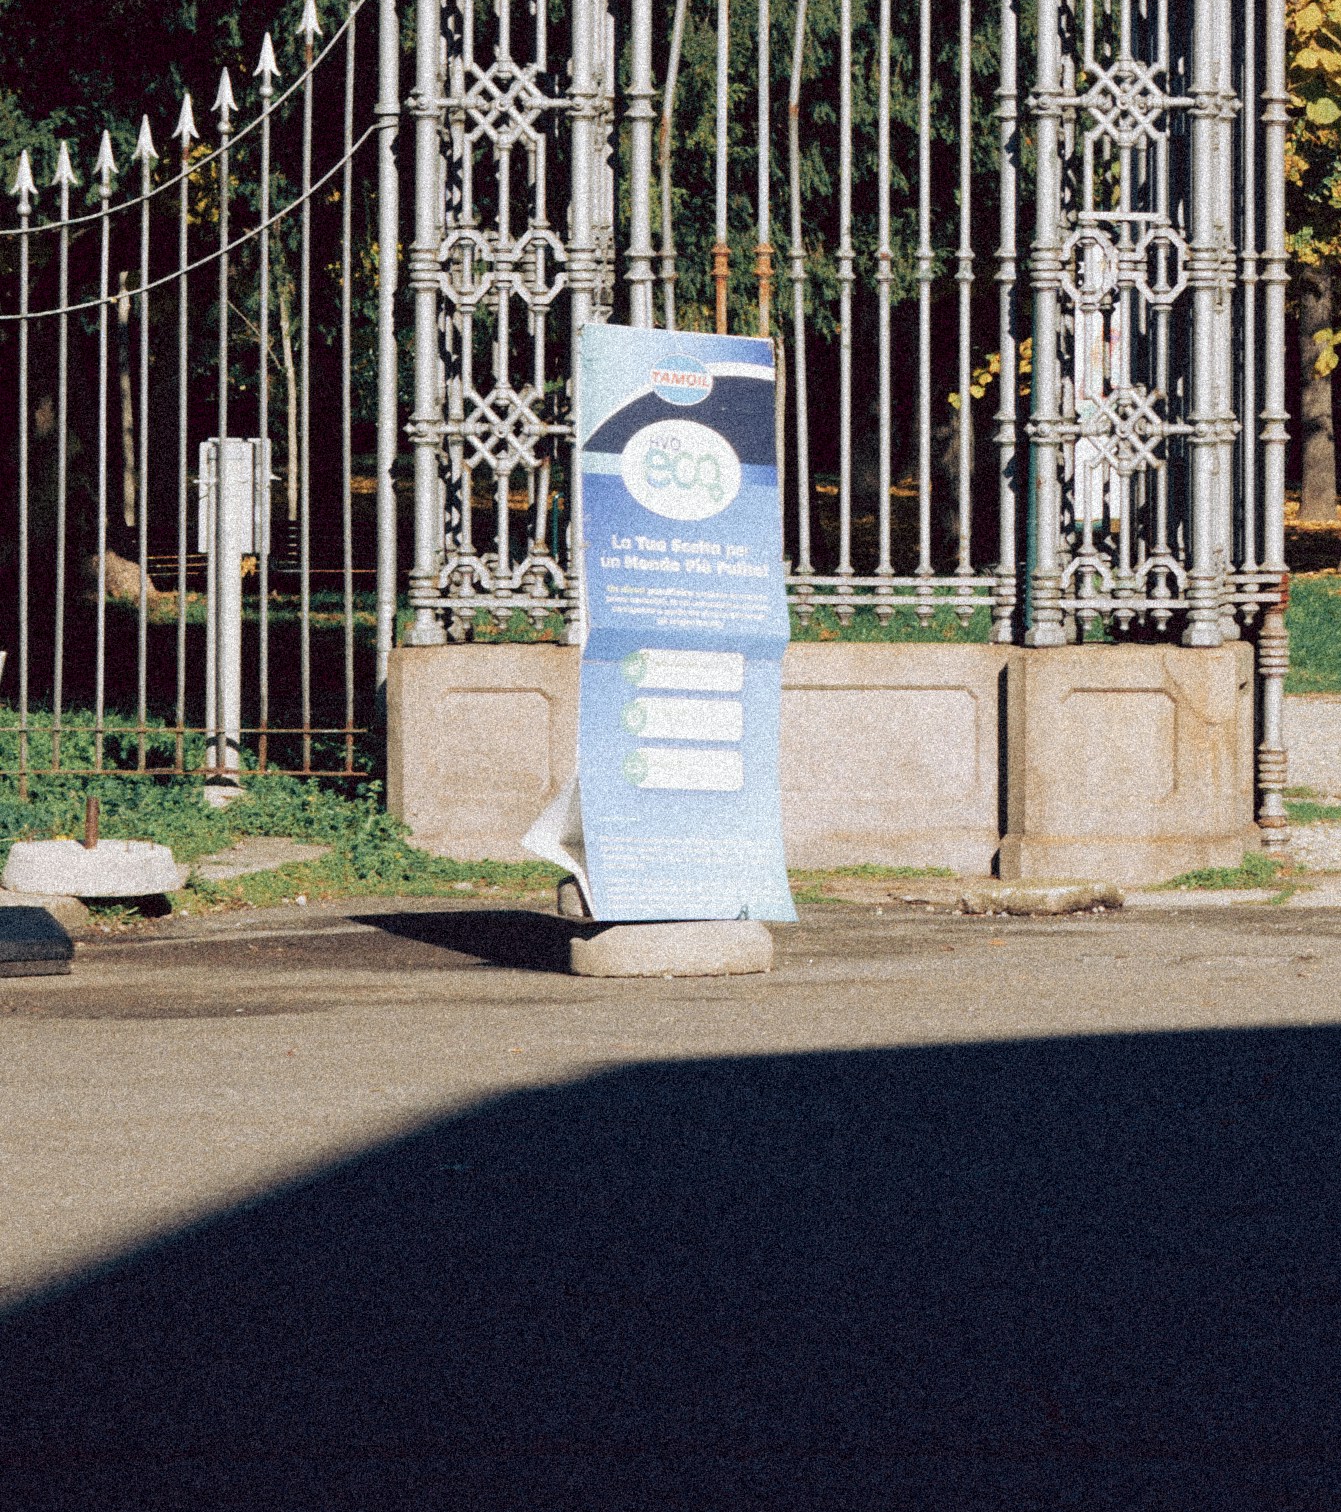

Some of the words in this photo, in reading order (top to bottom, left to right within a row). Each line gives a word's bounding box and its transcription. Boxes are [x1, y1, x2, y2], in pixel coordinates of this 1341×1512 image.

[651, 370, 710, 388] TAMOIL
[648, 435, 681, 455] HVO
[611, 533, 632, 550] La
[635, 535, 668, 553] Tua
[671, 538, 721, 556] Scelta
[600, 556, 622, 569] un
